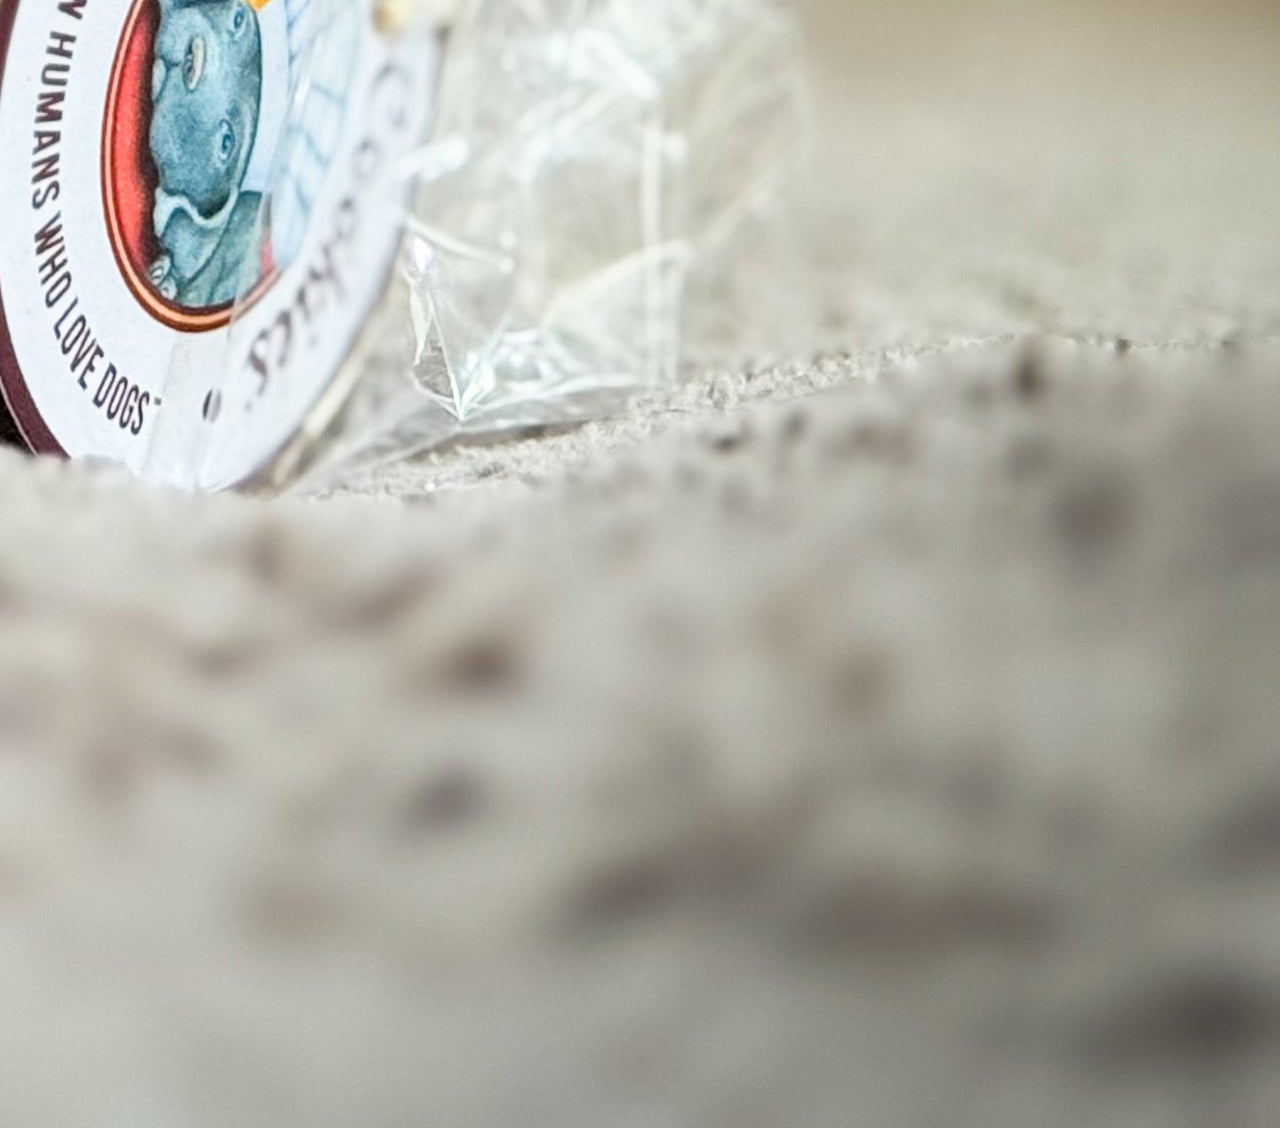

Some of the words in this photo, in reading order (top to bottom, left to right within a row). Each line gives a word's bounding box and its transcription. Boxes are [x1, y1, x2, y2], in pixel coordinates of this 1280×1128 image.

[31, 30, 77, 212] HUMANS
[32, 210, 72, 308] WHO
[54, 298, 106, 390] LOVE
